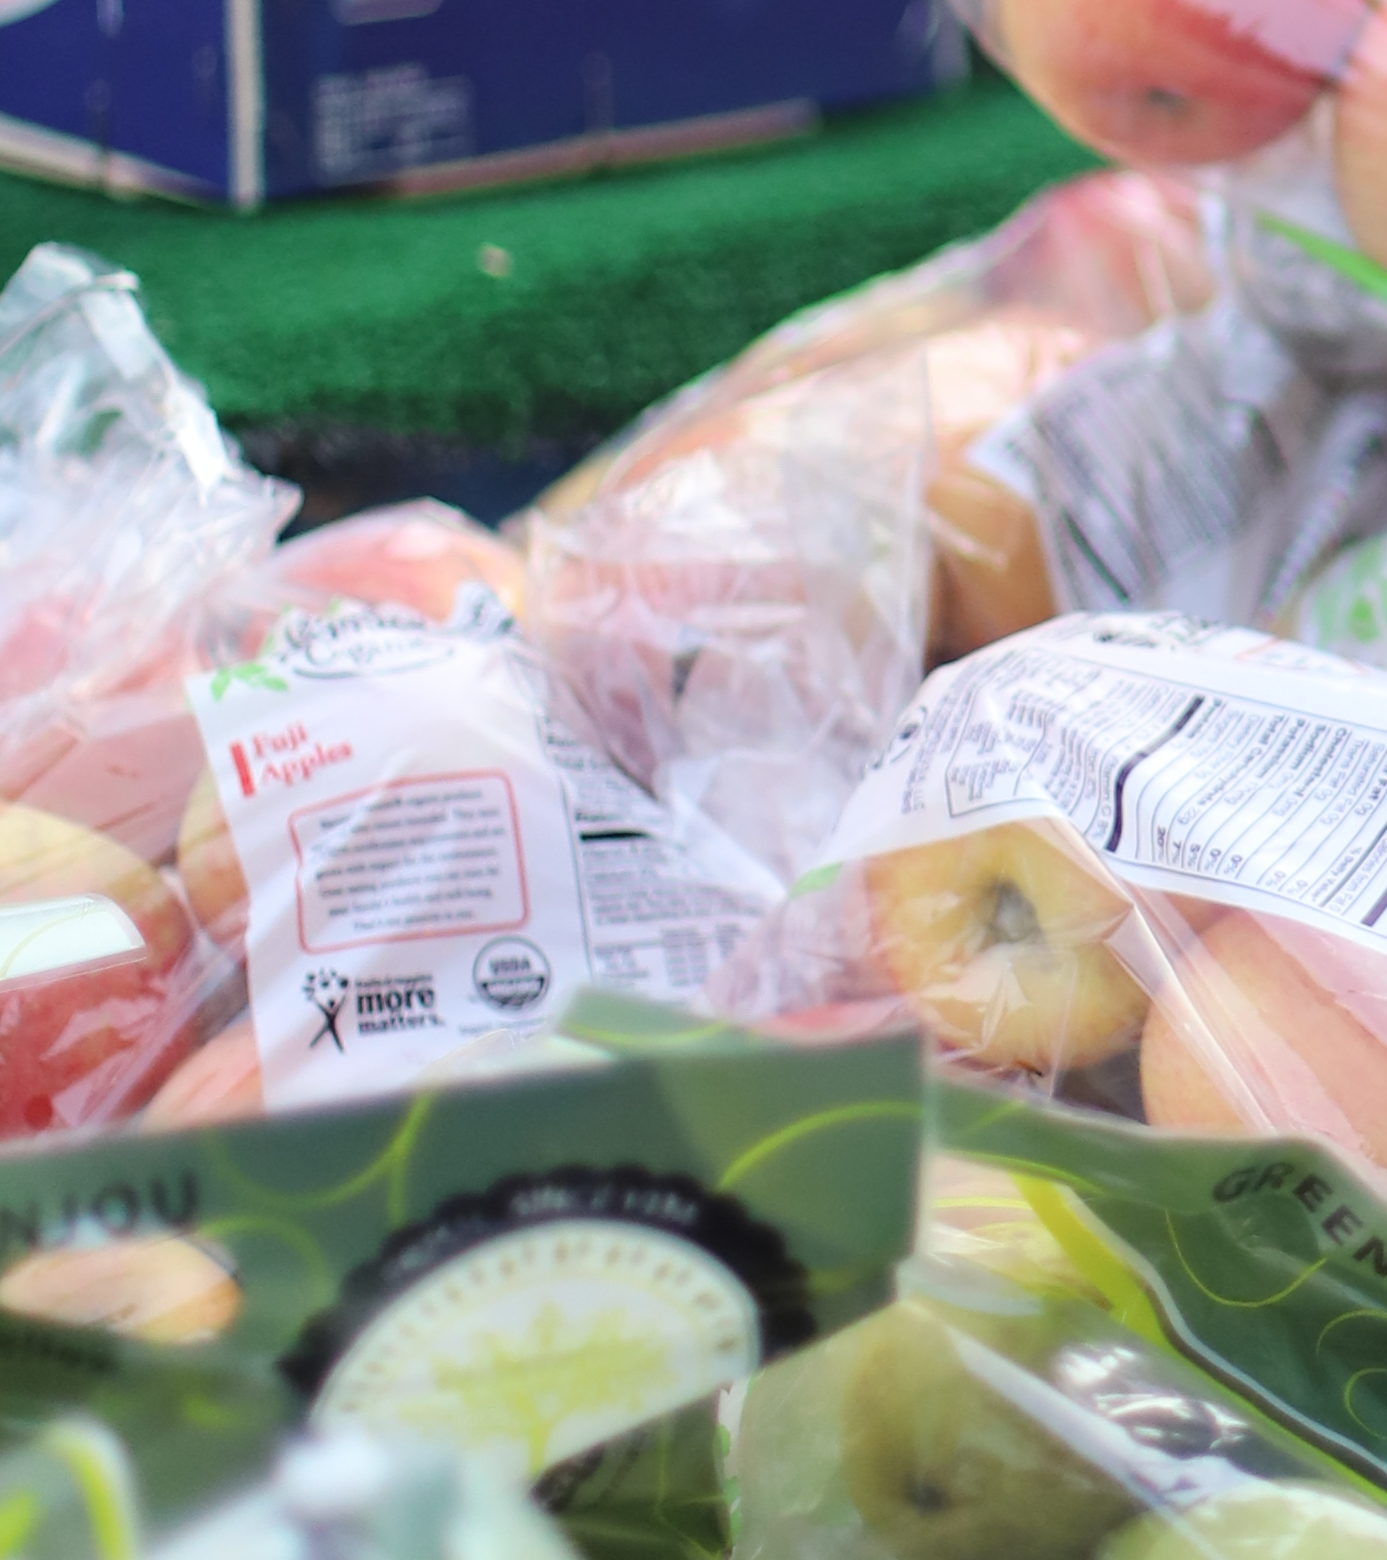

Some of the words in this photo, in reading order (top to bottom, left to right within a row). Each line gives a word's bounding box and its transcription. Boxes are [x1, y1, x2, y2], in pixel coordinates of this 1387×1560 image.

[251, 719, 308, 760] Fuji
[1289, 723, 1326, 771] Sodium
[262, 741, 353, 787] Apples
[356, 987, 435, 1015] more
